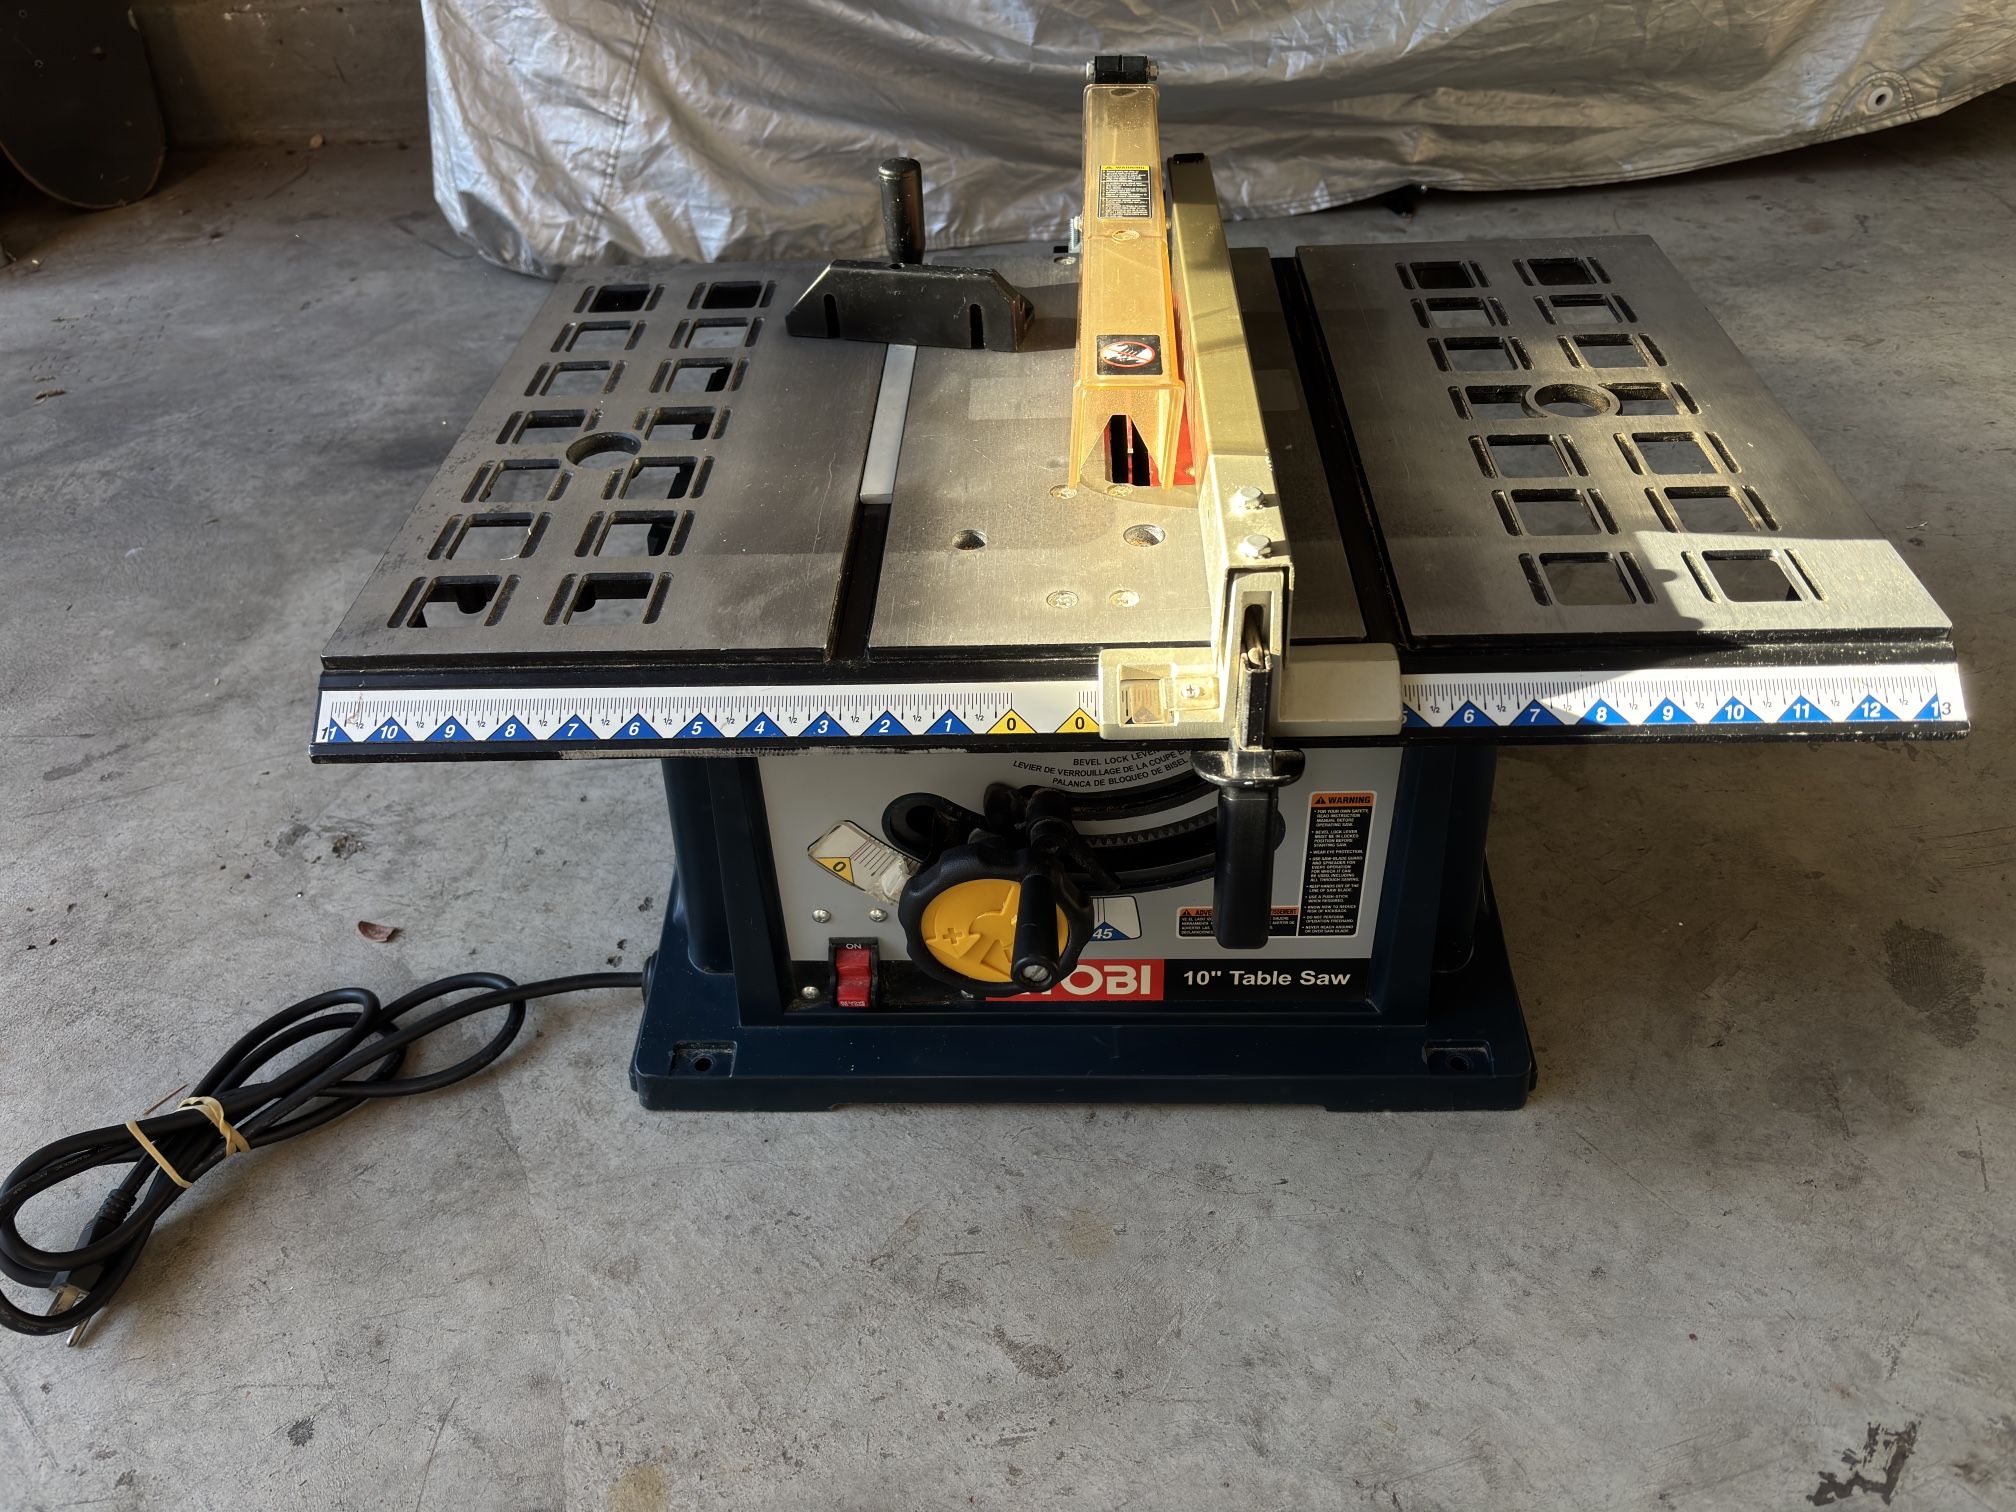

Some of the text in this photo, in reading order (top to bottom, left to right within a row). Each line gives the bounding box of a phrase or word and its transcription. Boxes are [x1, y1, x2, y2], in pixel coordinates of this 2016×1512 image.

[1464, 710, 1475, 722] 6
[1530, 709, 1541, 722] 7
[1596, 707, 1607, 722] 8
[1662, 706, 1674, 720] 9
[1725, 704, 1744, 720] 10
[1793, 703, 1810, 719] 11
[1861, 702, 1881, 718] 12
[1930, 702, 1952, 718] 13
[322, 717, 1085, 739] 11 10 9 8 7 6 5 4 3 2 1 0 0
[1013, 760, 1042, 773] LEVIER
[1044, 766, 1056, 774] DE
[1057, 766, 1121, 777] VERROUILLAGE
[1123, 764, 1134, 773] DE
[1136, 762, 1148, 770] LA
[1149, 751, 1177, 766] COUPE
[1073, 758, 1101, 766] BEVEL
[1104, 755, 1128, 764] LOCK
[1052, 777, 1091, 788] PALANCA
[1108, 771, 1149, 784] BLOQUEO
[1151, 767, 1163, 776] DE
[1165, 758, 1188, 770] BISEL
[832, 861, 846, 872] 0
[1092, 928, 1114, 939] 45
[1022, 965, 1351, 995] OBI 10" Table Saw
